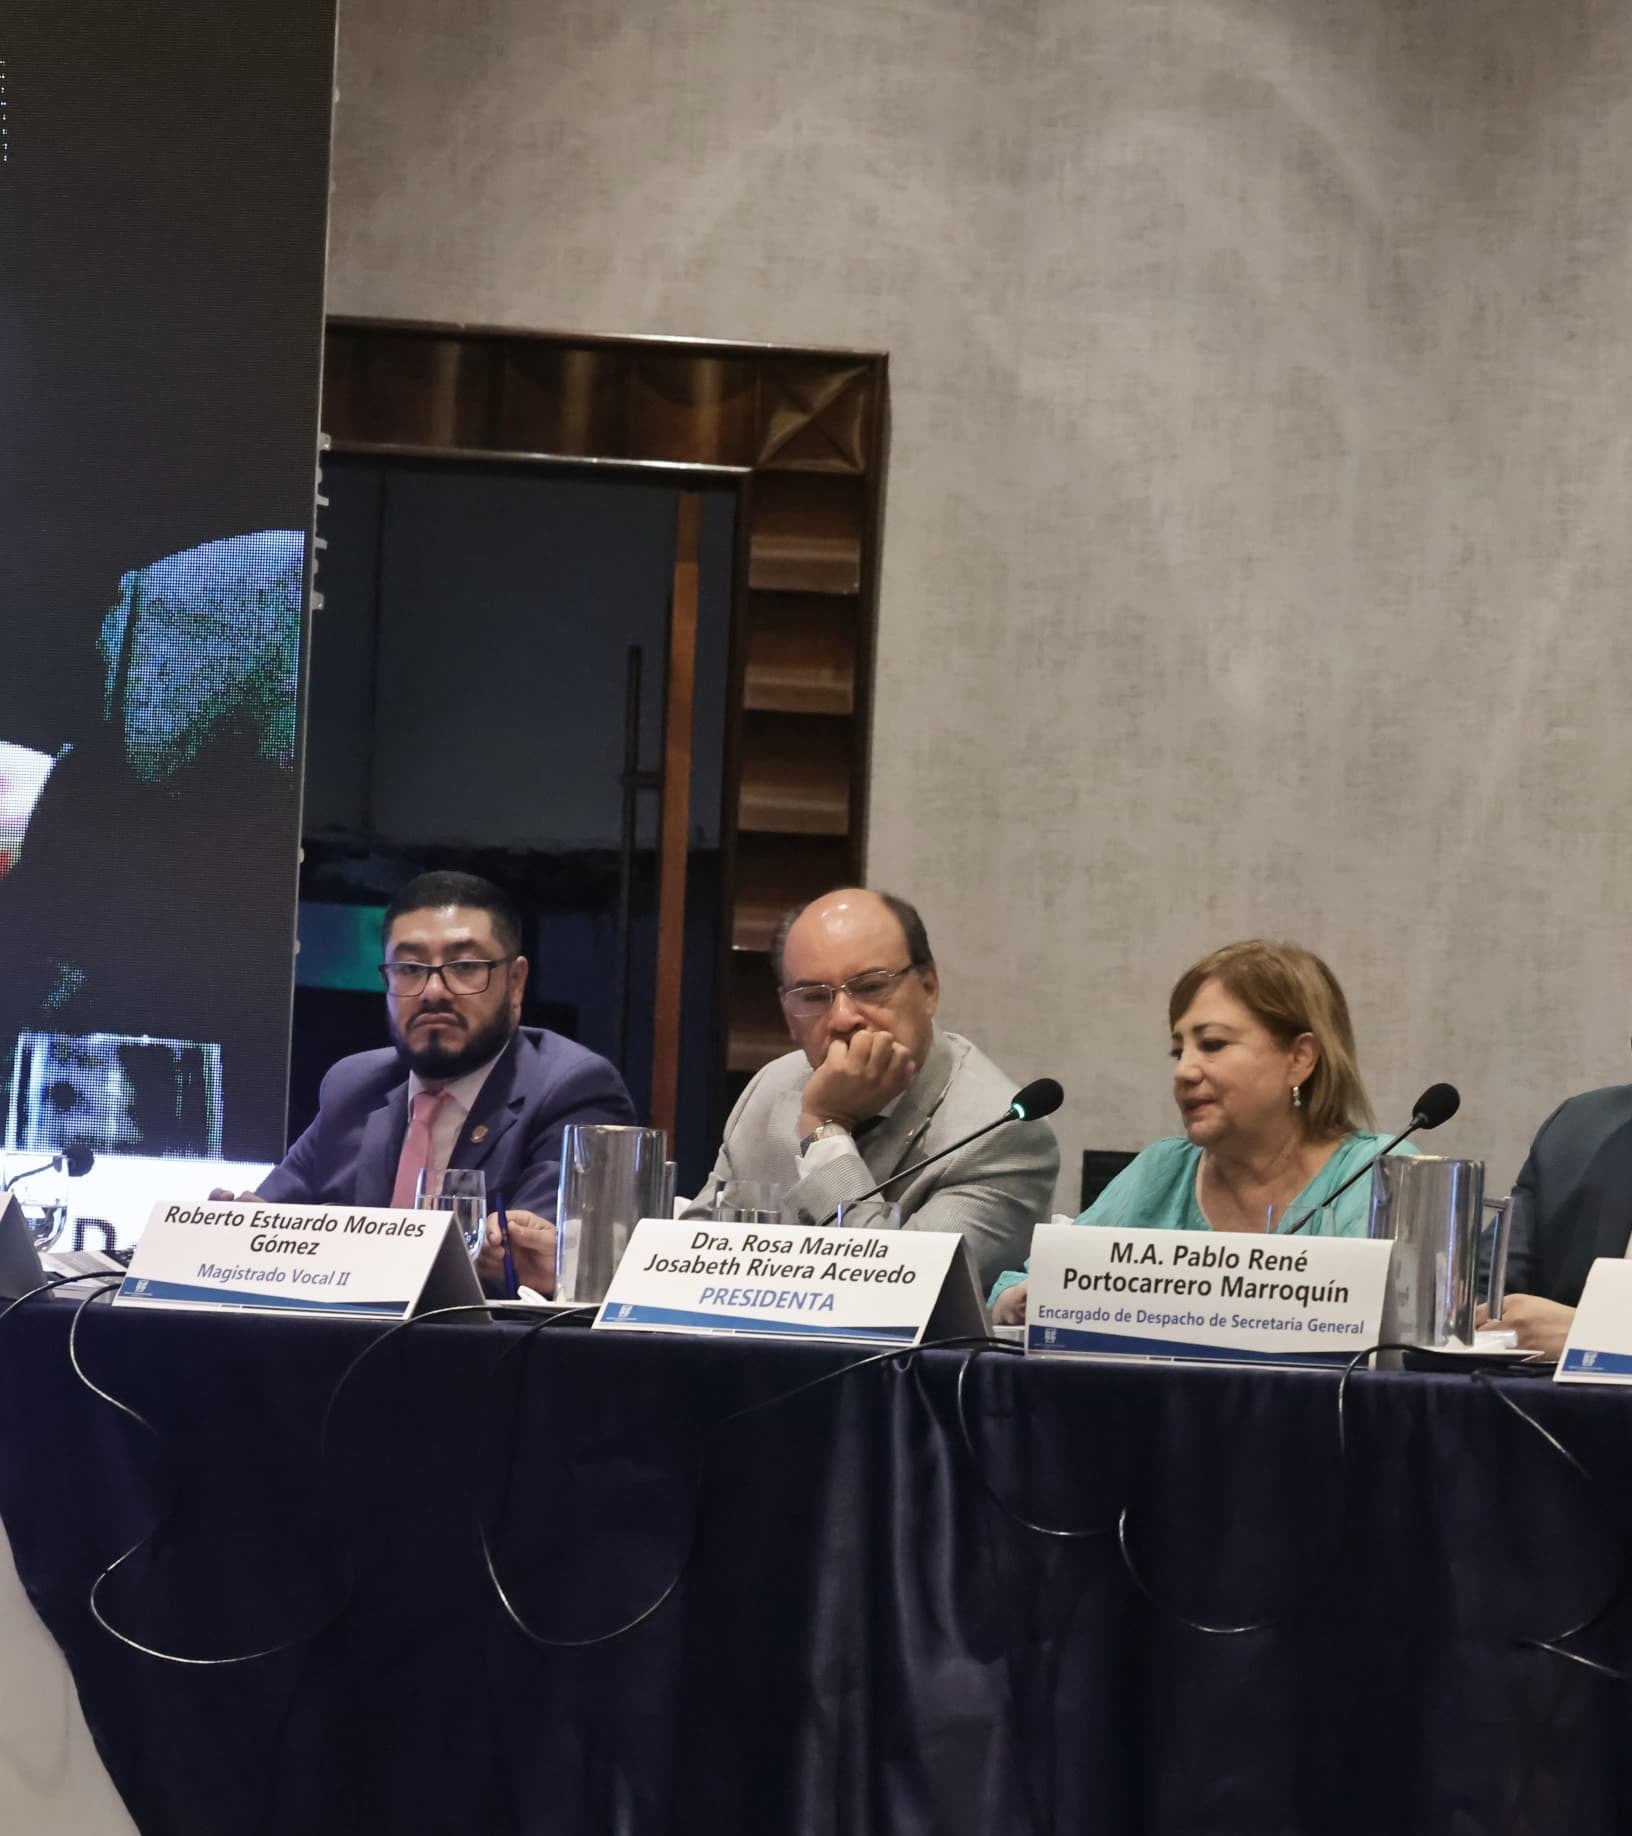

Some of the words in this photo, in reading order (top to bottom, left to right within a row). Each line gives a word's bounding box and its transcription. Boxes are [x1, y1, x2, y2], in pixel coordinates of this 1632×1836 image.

[164, 1205, 245, 1227] Roberto
[249, 1210, 338, 1233] Estuardo
[343, 1215, 427, 1238] Morales
[250, 1233, 321, 1256] Gómez
[690, 1231, 733, 1252] Dra.
[741, 1234, 794, 1254] Rosa
[799, 1236, 889, 1259] Mariella
[1110, 1241, 1164, 1266] M.A.
[1172, 1244, 1240, 1269] Pablo
[1247, 1248, 1308, 1273] René
[196, 1263, 287, 1284] Magistrado
[291, 1269, 334, 1286] Vocal
[335, 1271, 352, 1286] II
[643, 1253, 741, 1276] Josabeth
[746, 1257, 815, 1279] Rivera
[819, 1262, 917, 1285] Acevedo
[698, 1287, 835, 1312] PRESIDENTA
[1063, 1267, 1212, 1297] Portocarrero
[1220, 1275, 1349, 1309] Marroquín
[1038, 1304, 1111, 1325] Encargado
[1114, 1307, 1133, 1323] de
[1136, 1309, 1205, 1329] Despacho
[1209, 1312, 1227, 1328] de
[1230, 1313, 1303, 1332] Secretaria
[1307, 1317, 1365, 1335] General
